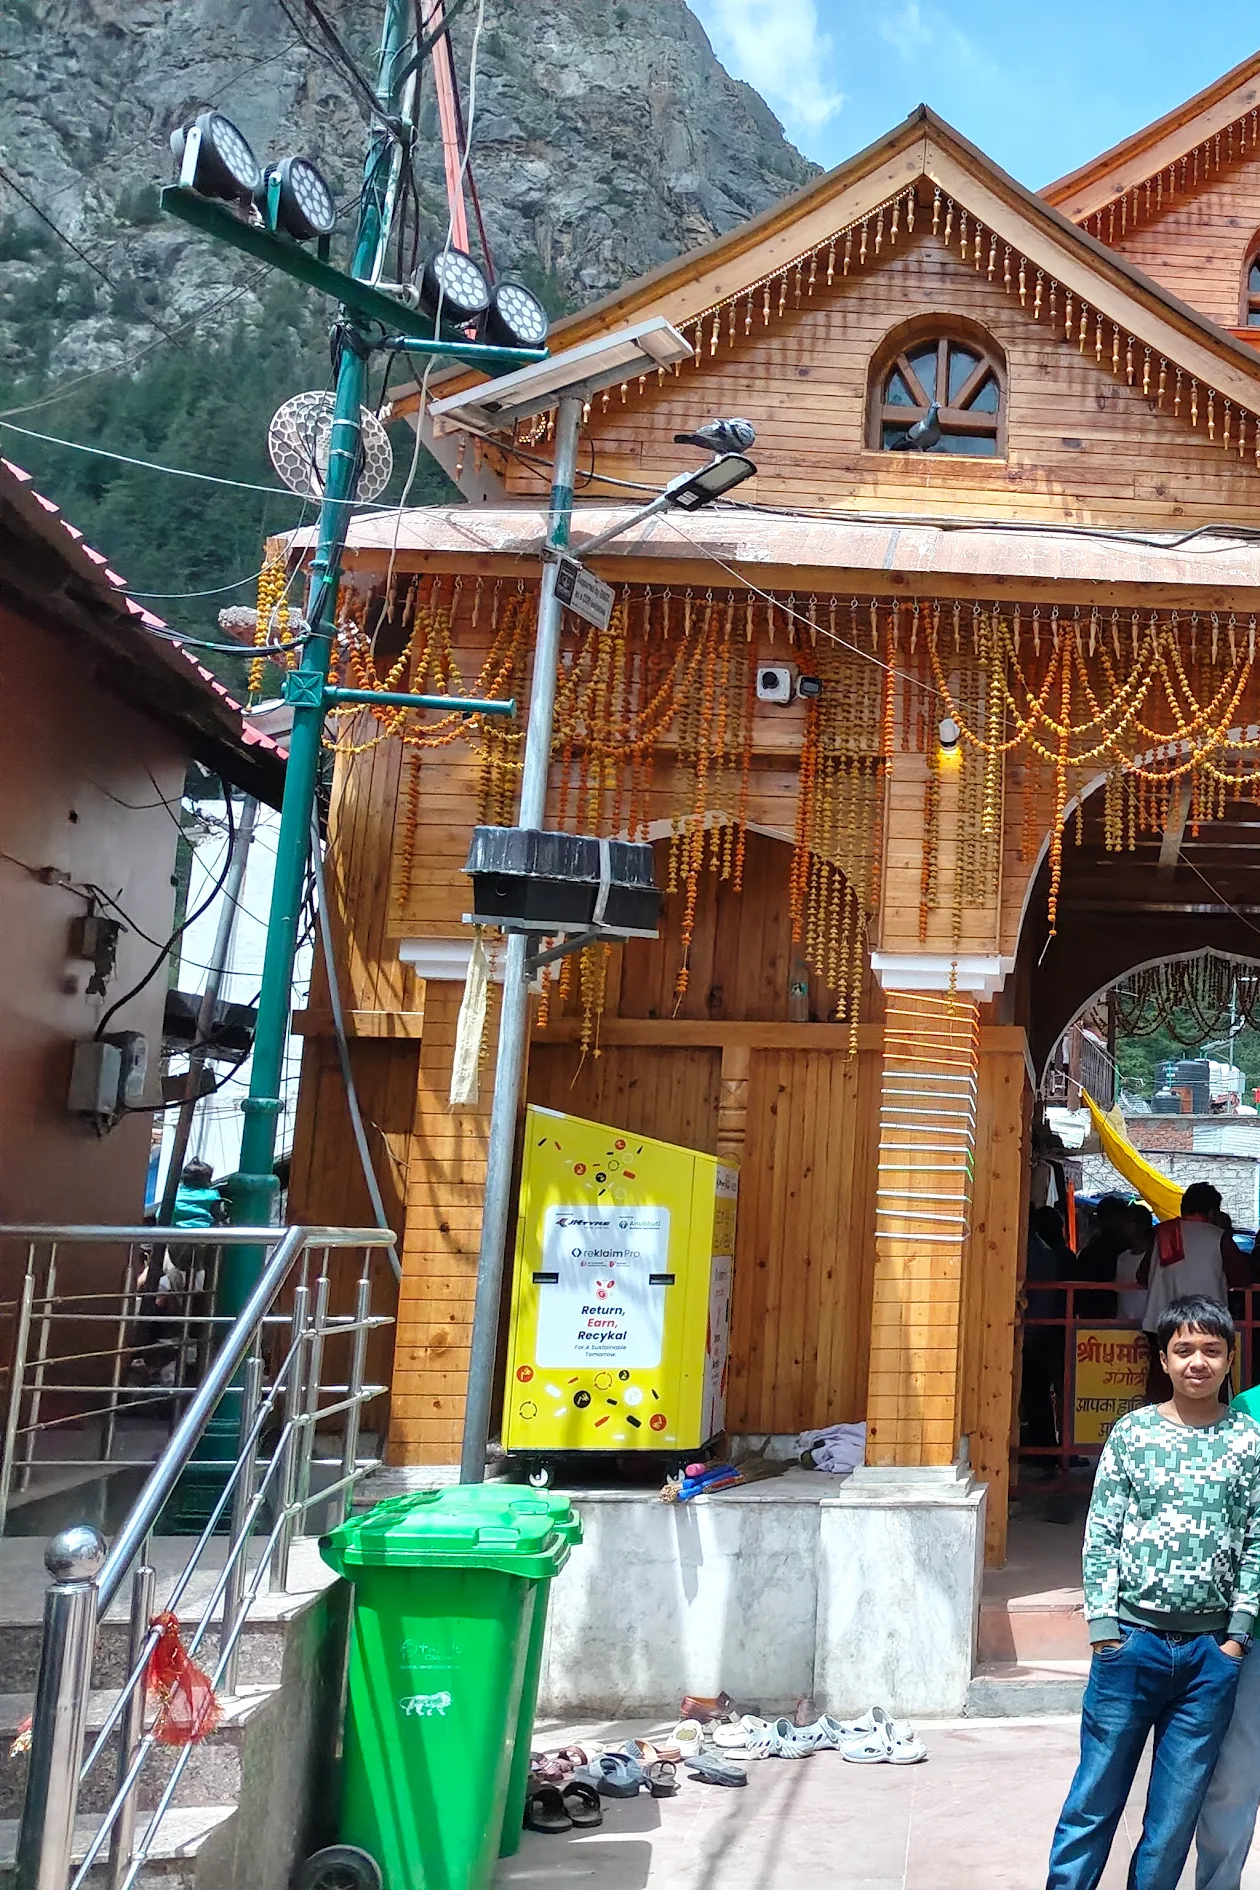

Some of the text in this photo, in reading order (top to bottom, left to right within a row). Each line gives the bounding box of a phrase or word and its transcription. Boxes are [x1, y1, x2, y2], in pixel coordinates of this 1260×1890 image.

[581, 1305, 625, 1317] Return,
[587, 1318, 618, 1329] Earn,
[577, 1330, 627, 1343] Recykal
